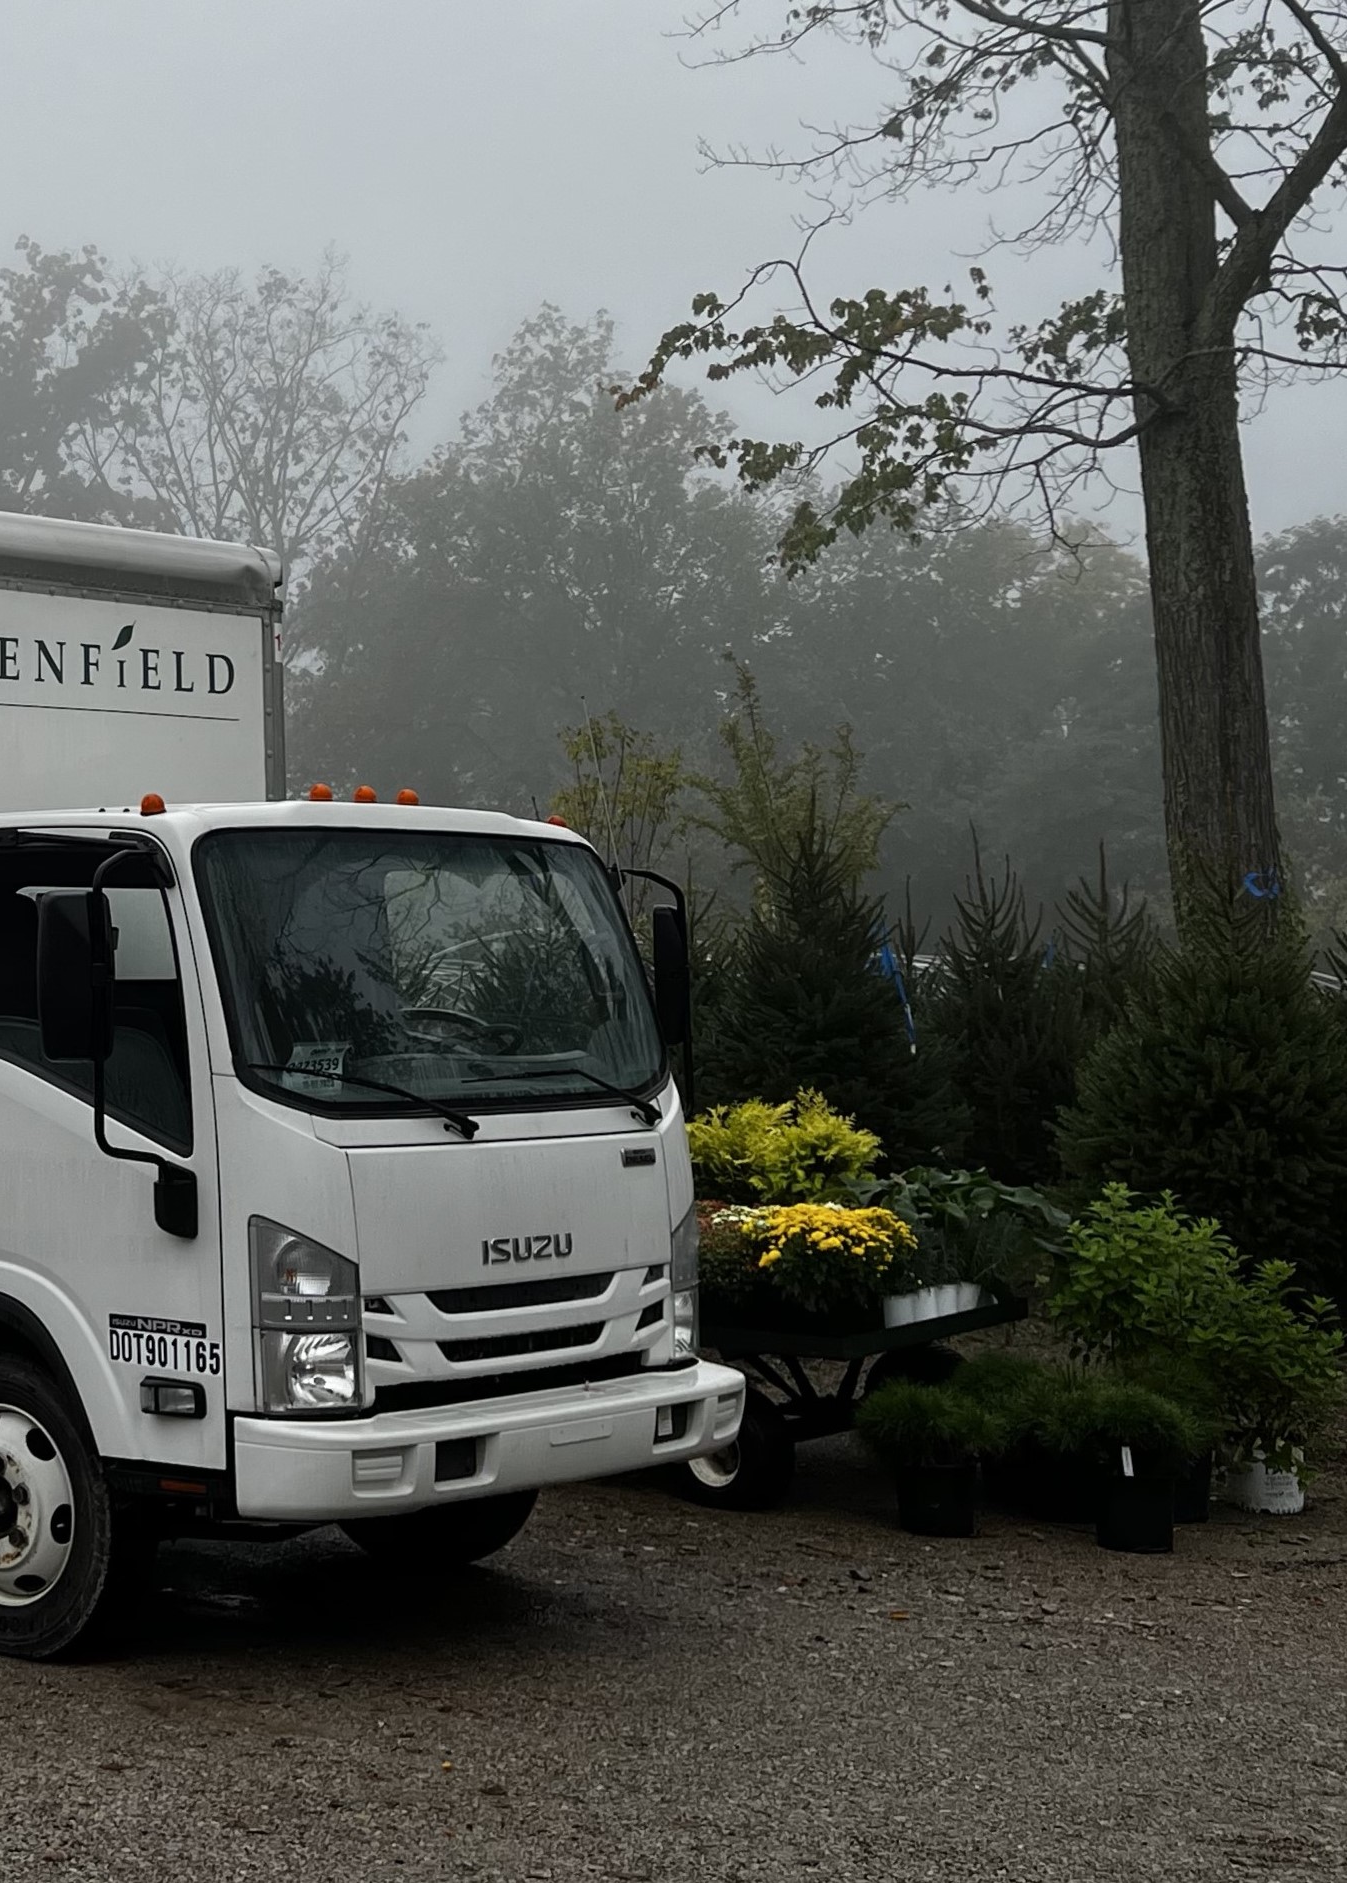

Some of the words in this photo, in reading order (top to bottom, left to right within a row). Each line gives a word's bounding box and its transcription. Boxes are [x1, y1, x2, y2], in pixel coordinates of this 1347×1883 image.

[481, 1232, 573, 1265] ISUZU
[112, 1317, 137, 1327] ISUZU
[137, 1318, 182, 1335] NPR
[109, 1329, 220, 1374] DOT901165
